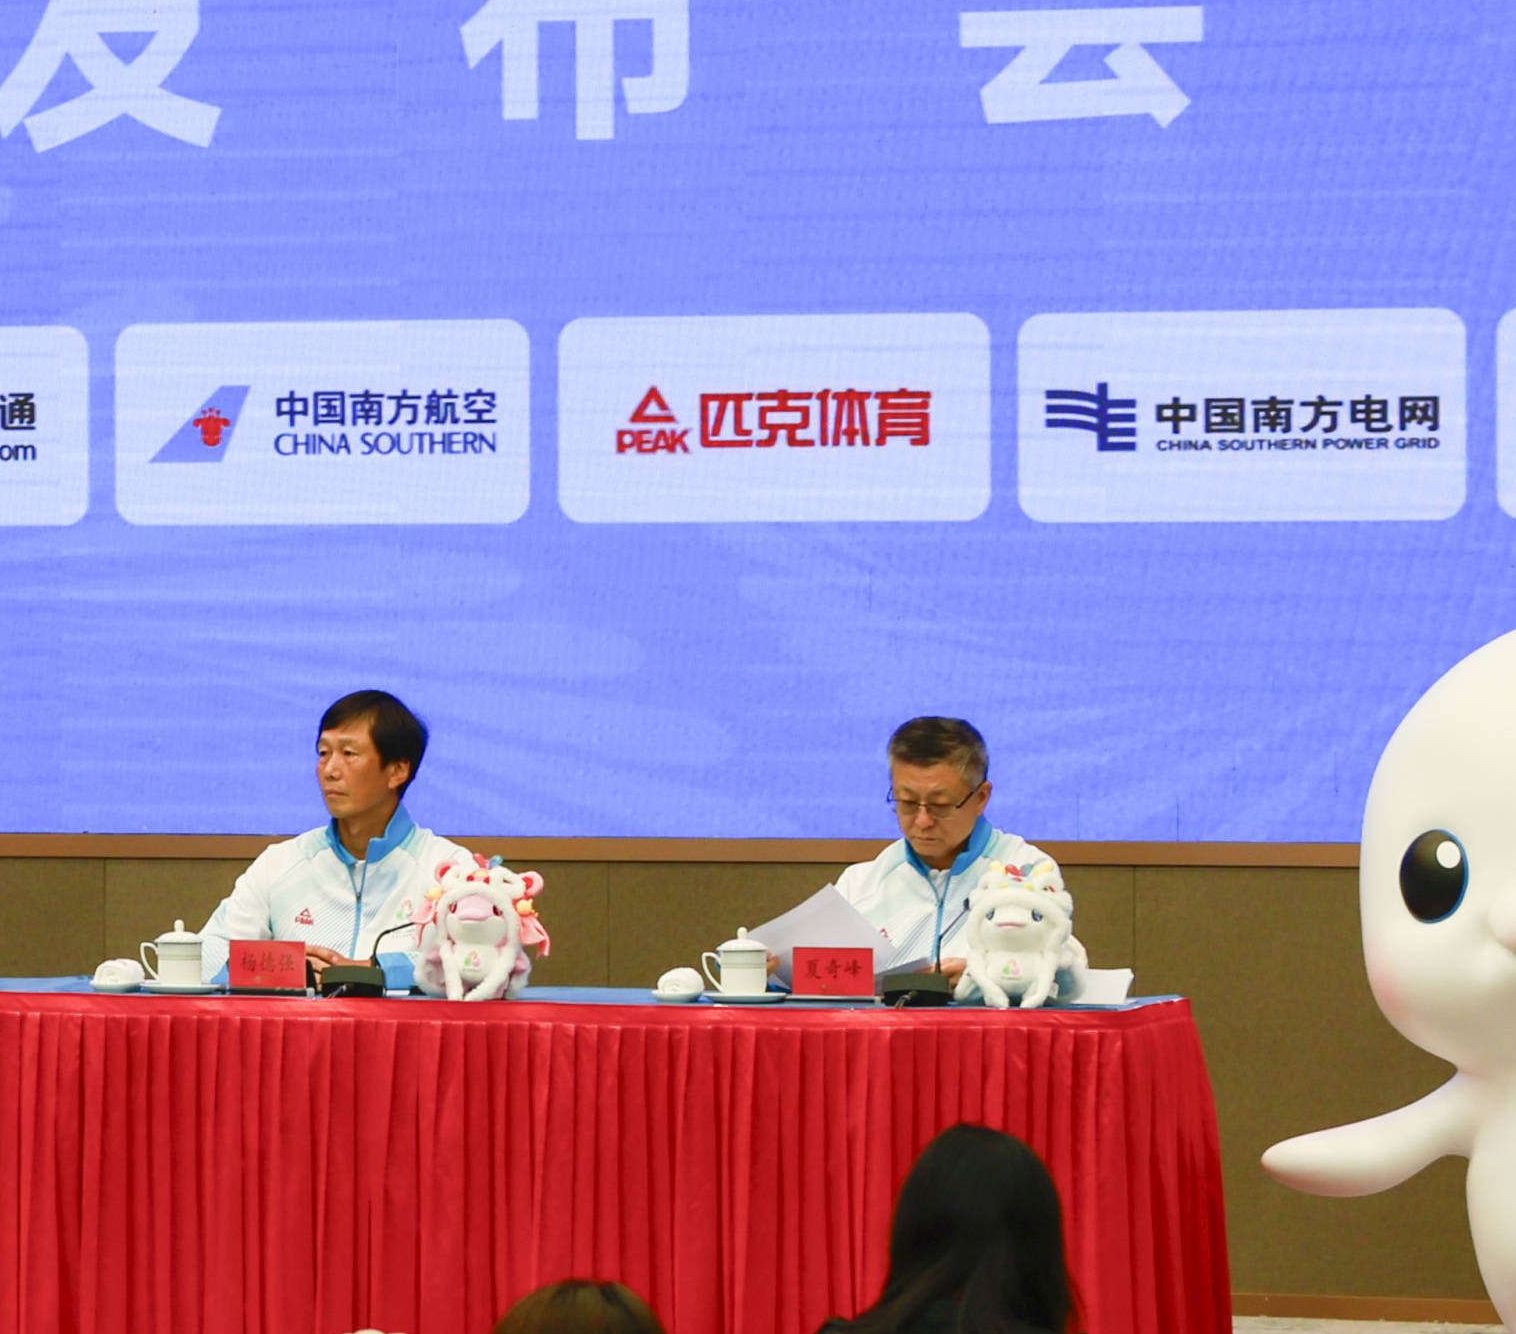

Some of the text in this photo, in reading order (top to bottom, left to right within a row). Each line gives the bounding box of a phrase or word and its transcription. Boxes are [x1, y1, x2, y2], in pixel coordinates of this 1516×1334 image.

[275, 388, 497, 428] 中国南方航空
[700, 388, 932, 448] 匹克体育
[1155, 394, 1440, 435] 中国南方电网
[273, 431, 497, 456] CHINA SOUTHERN
[616, 429, 689, 454] PEAK
[1156, 437, 1440, 452] CHINA SOUTHERN POWER GRID
